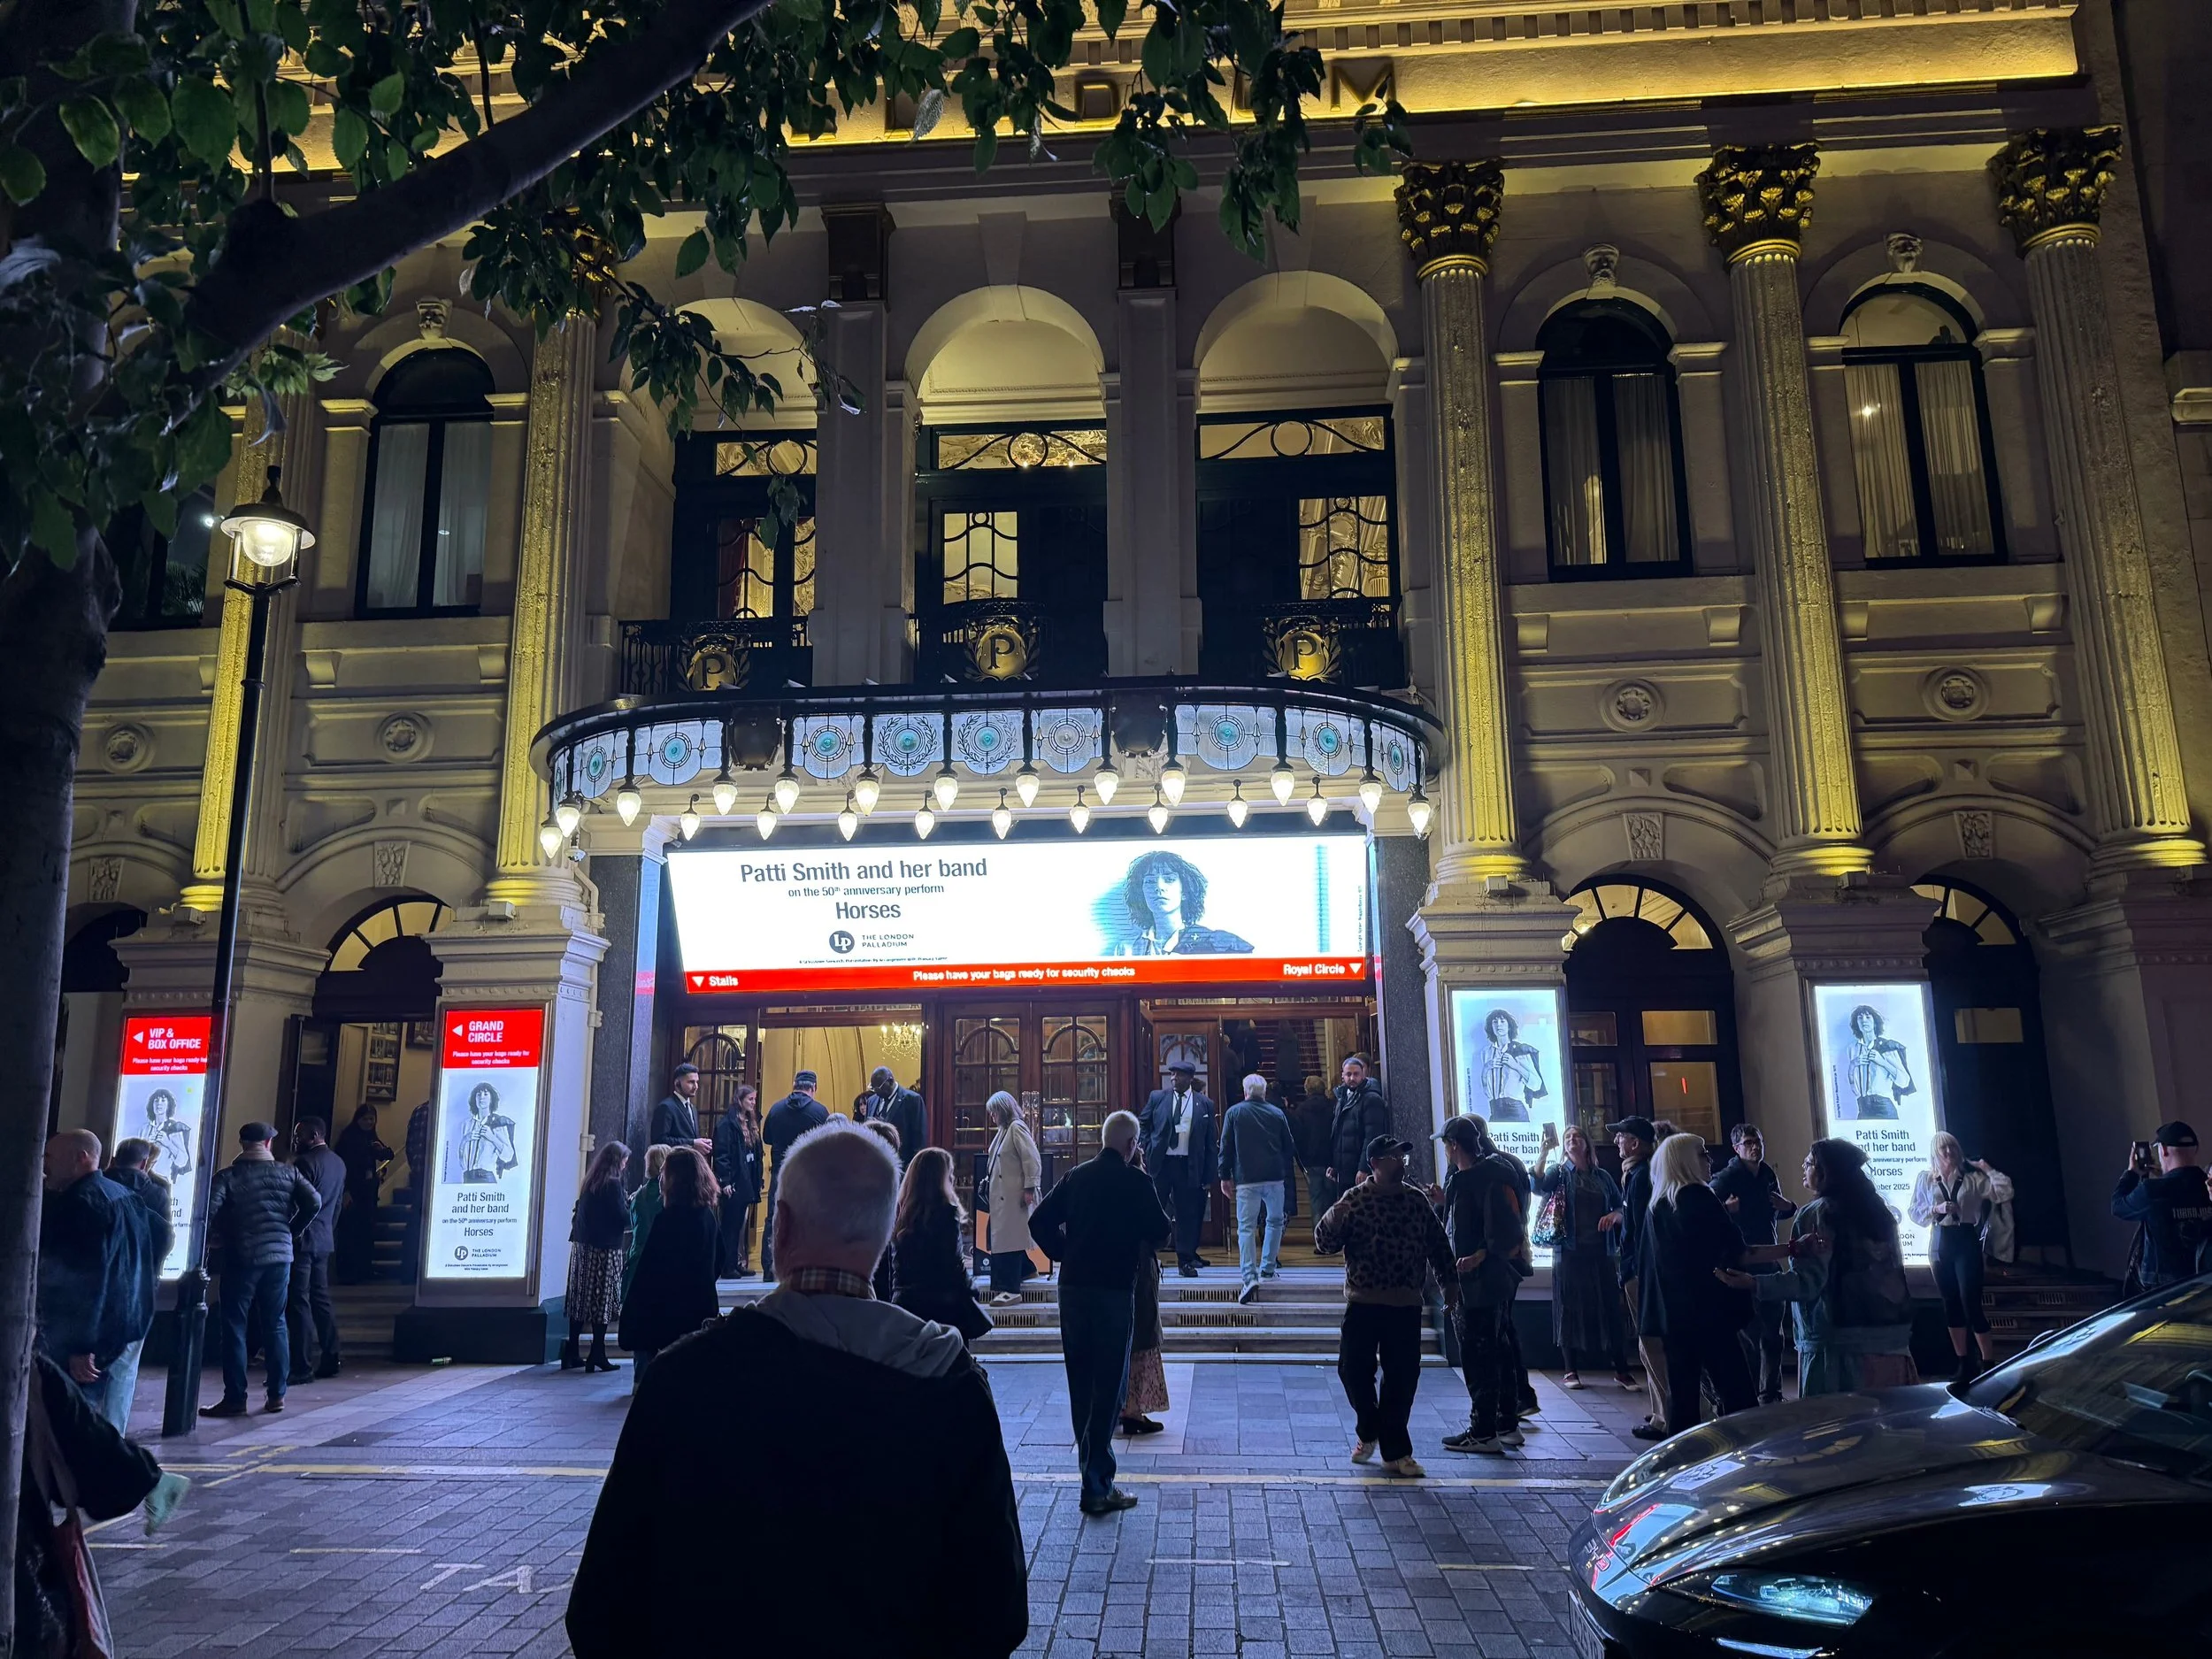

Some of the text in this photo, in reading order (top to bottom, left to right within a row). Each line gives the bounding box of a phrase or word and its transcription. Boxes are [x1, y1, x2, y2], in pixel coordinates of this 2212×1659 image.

[987, 634, 1015, 670] P
[1289, 634, 1317, 671] P
[700, 654, 726, 689] P
[741, 858, 987, 882] Patti Smith and her band
[788, 887, 801, 897] on
[803, 887, 819, 897] the
[843, 885, 901, 897] anniversary
[904, 884, 944, 896] perform
[835, 902, 901, 919] Horses
[913, 966, 1135, 980] Please have your bags ready for security checks
[1284, 963, 1345, 977] Royal Circle
[709, 976, 738, 987] Stalls
[469, 1021, 503, 1032] GRAND
[150, 1028, 173, 1038] VIP &
[468, 1032, 503, 1042] CIRCLE
[148, 1039, 202, 1049] BOX OFFICE
[1512, 1133, 1540, 1141] Smith
[1856, 1130, 1909, 1140] Patti Smith
[1522, 1145, 1540, 1154] ban
[1873, 1142, 1888, 1151] her
[1892, 1142, 1916, 1151] band
[1870, 1167, 1902, 1176] Horses
[457, 1192, 505, 1202] Patti Smith
[452, 1204, 509, 1213] and her band
[465, 1227, 494, 1236] Horses
